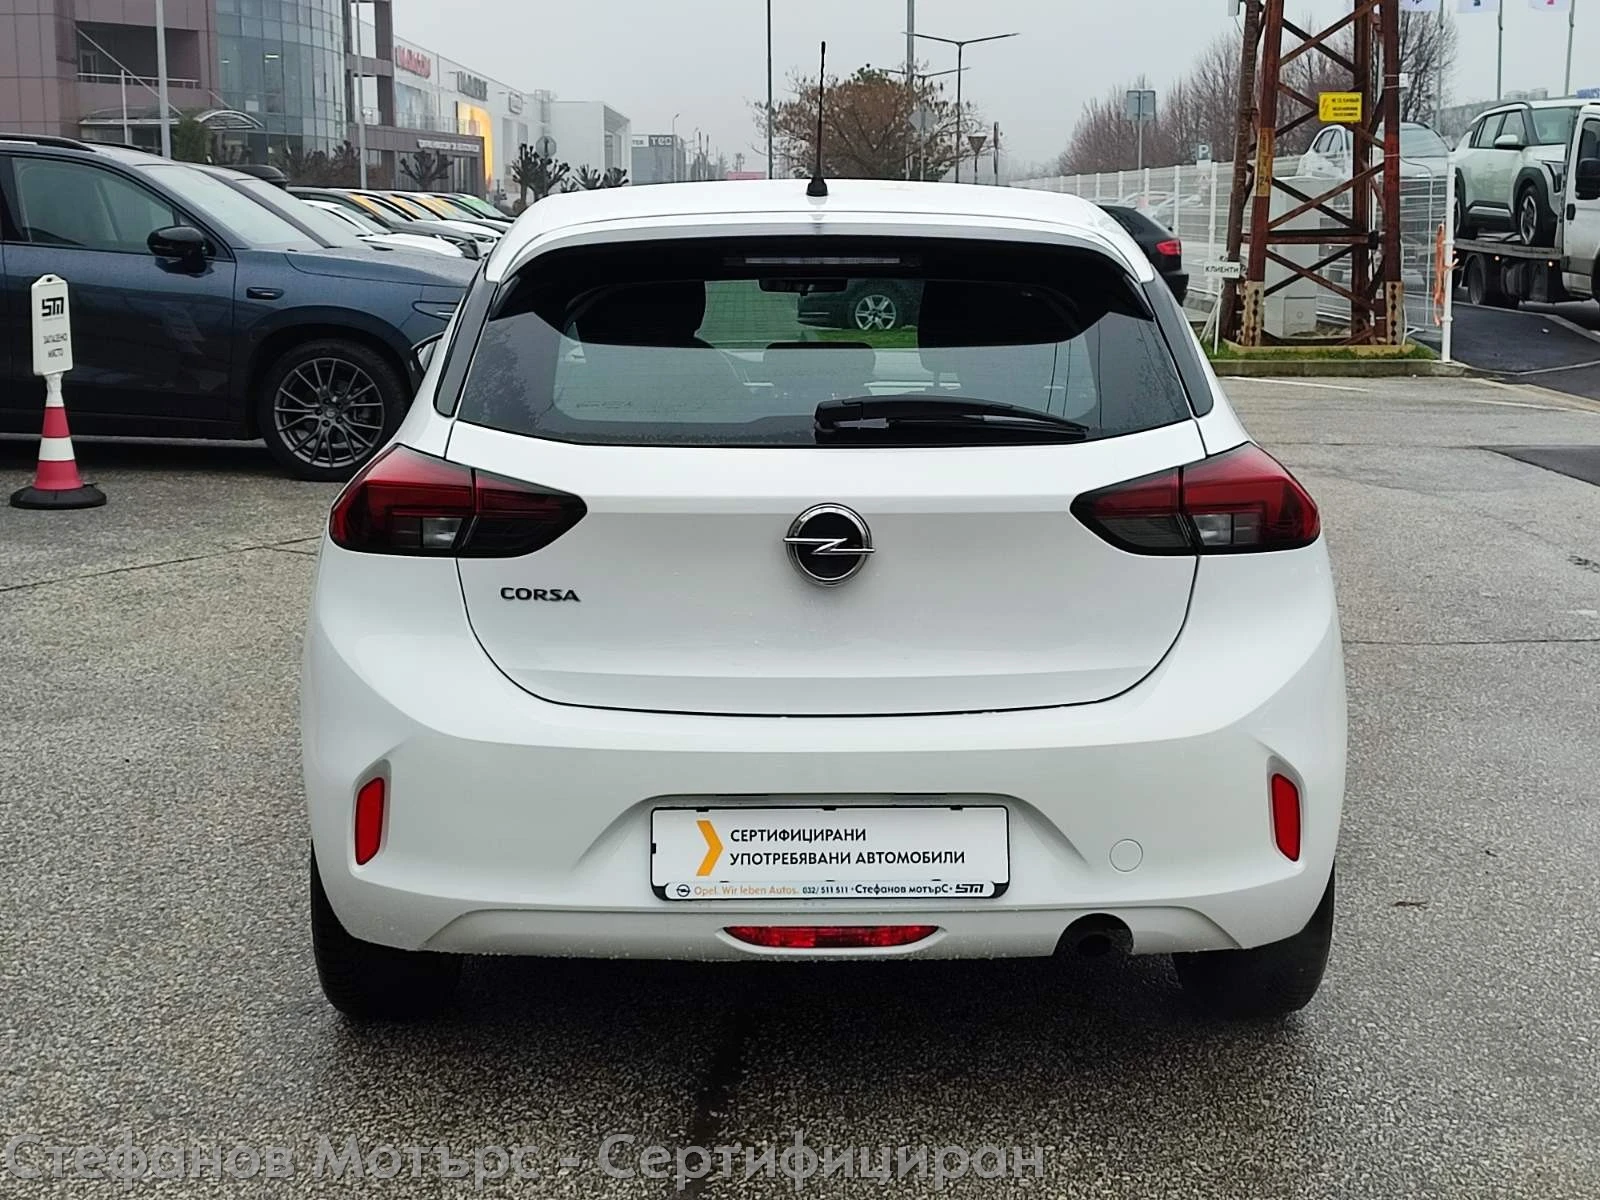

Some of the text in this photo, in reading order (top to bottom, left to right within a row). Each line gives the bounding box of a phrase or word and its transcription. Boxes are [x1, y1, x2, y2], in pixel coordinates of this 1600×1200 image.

[1199, 144, 1209, 159] P
[1205, 265, 1239, 273] КЛИЕНТИ
[500, 587, 581, 602] CORSA
[730, 828, 867, 844] СЕРТИФИЦИРАНИ
[729, 851, 966, 866] УПОТРЕБЯВАНИ АВТОМОБИЛИ
[721, 885, 738, 895] Wir
[740, 885, 767, 895] leben
[855, 884, 907, 896] Стефанов
